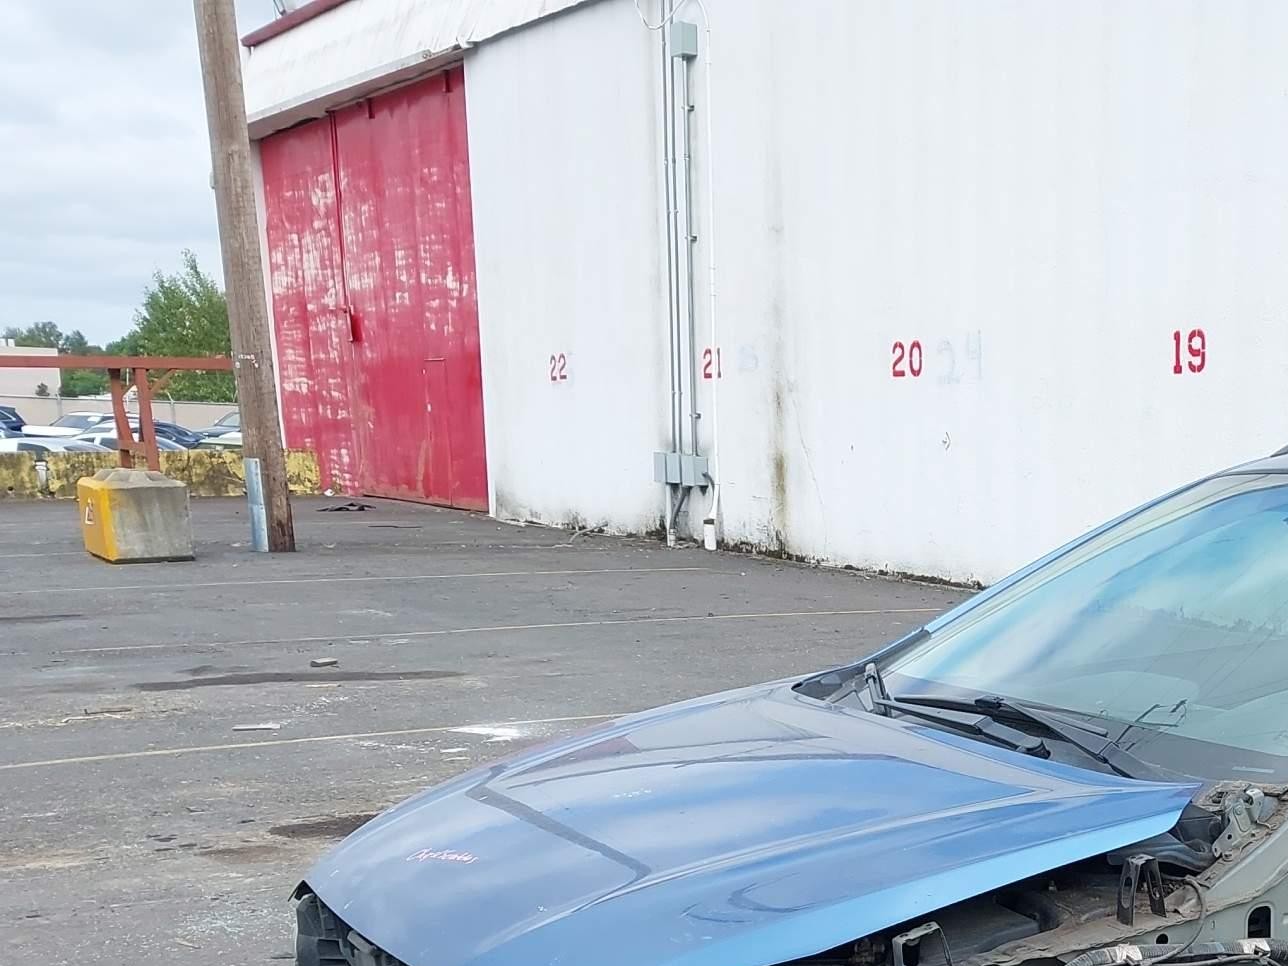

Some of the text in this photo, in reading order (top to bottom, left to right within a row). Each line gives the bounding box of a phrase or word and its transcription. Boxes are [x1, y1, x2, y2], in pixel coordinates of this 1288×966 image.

[550, 353, 567, 382] 22
[703, 347, 722, 379] 21
[891, 340, 923, 378] 20
[1172, 328, 1207, 375] 19
